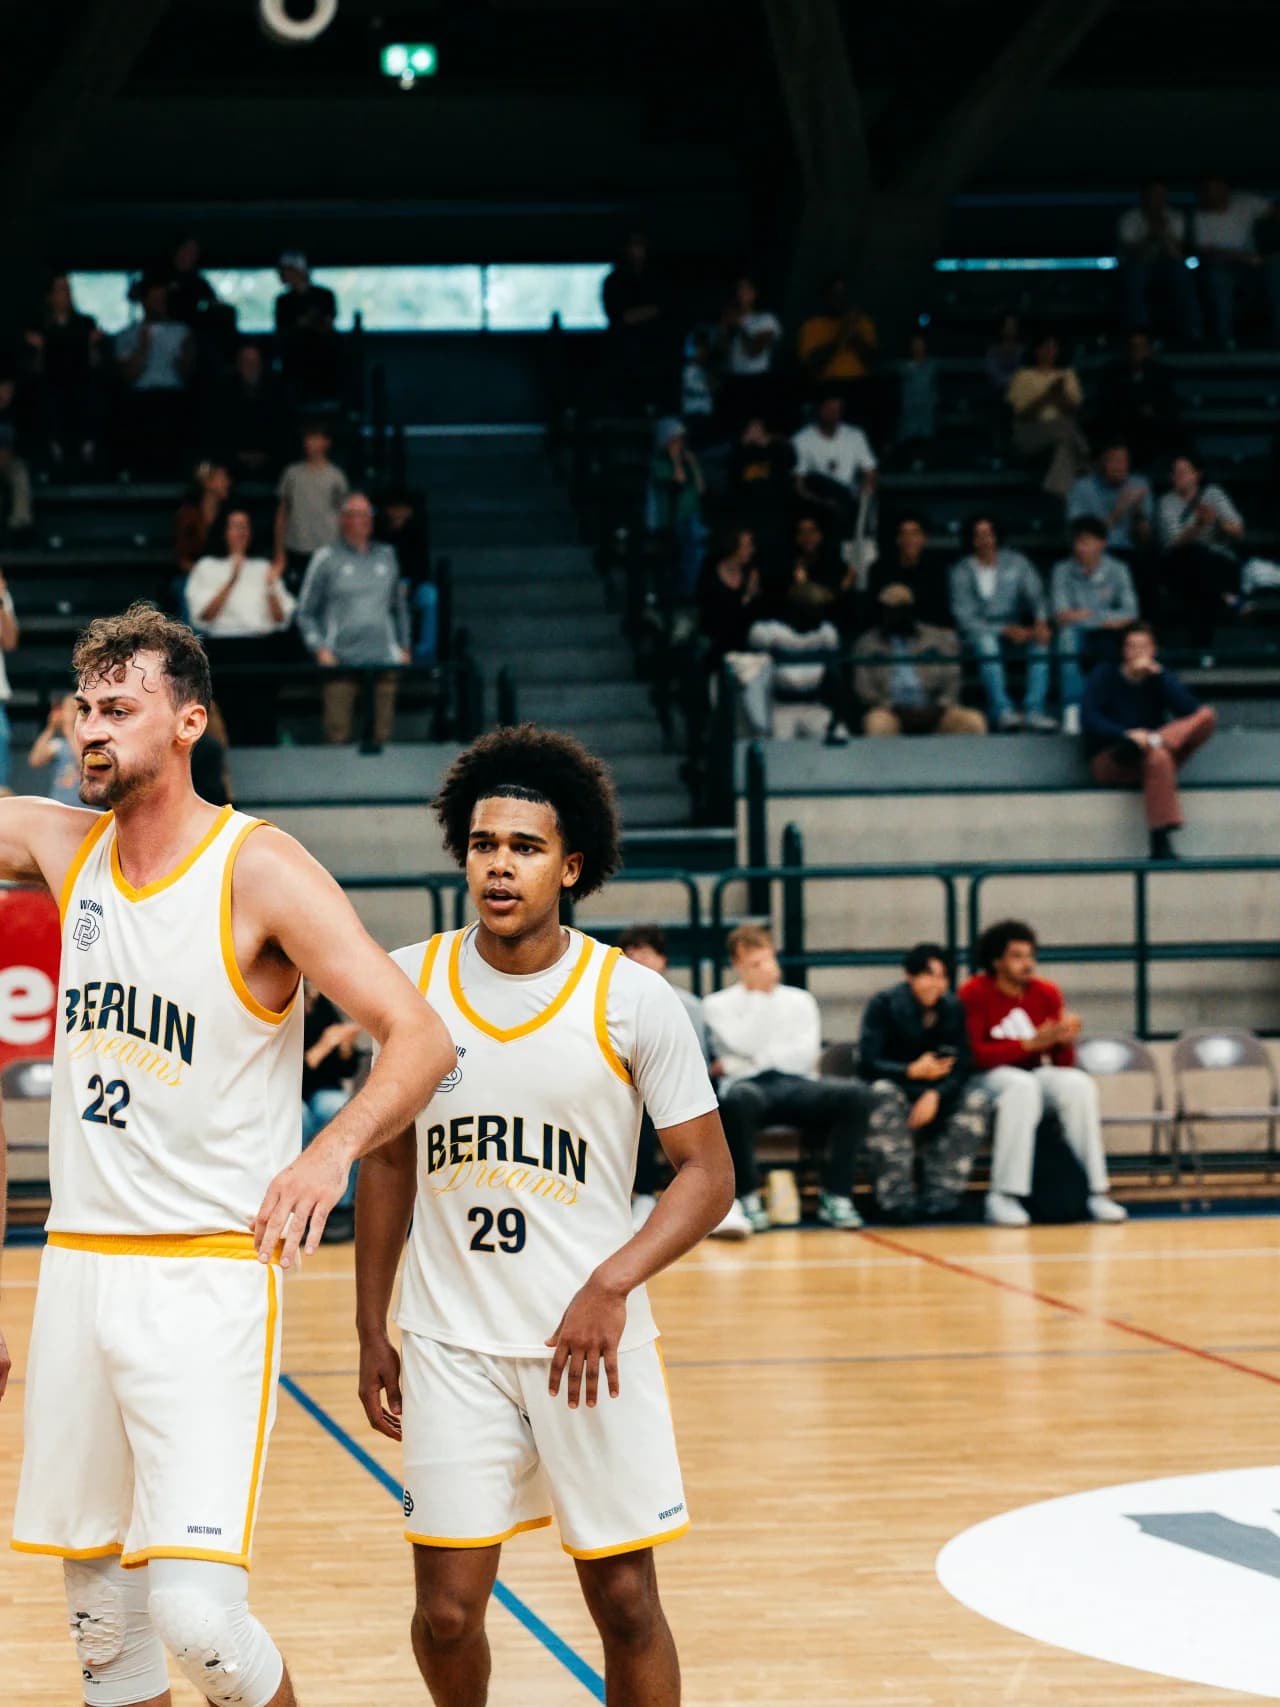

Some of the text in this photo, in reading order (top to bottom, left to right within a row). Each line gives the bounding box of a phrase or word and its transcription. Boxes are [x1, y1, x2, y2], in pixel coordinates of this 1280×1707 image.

[65, 981, 196, 1066] BERLIN
[81, 1073, 131, 1130] 22
[427, 1114, 588, 1185] BERLIN
[431, 1141, 579, 1206] Dreams
[467, 1206, 527, 1254] 29
